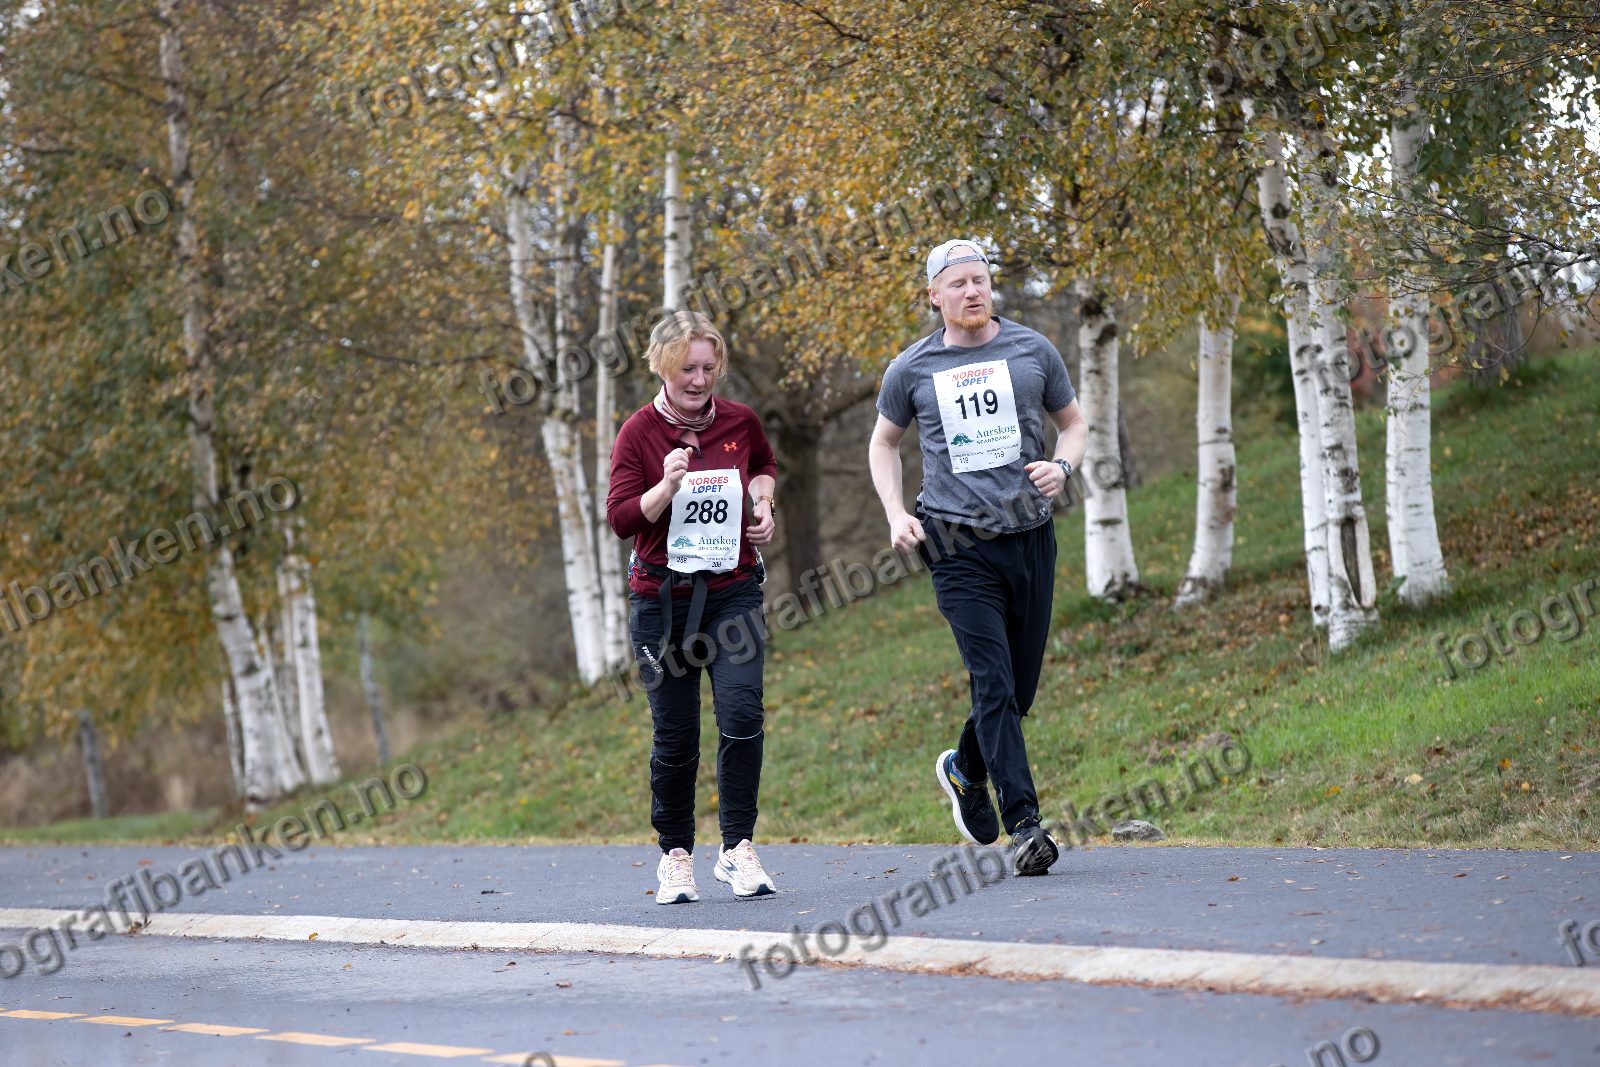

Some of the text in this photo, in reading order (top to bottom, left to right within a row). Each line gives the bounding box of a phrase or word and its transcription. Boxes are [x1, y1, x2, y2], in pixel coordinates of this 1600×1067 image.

[951, 368, 994, 382] NORGES
[956, 376, 988, 388] LØPET
[955, 389, 998, 420] 119
[976, 425, 1017, 439] Aurskog
[688, 476, 729, 486] NORGES
[692, 485, 723, 494] LØPET
[683, 499, 729, 525] 288
[698, 536, 737, 547] Aurskog
